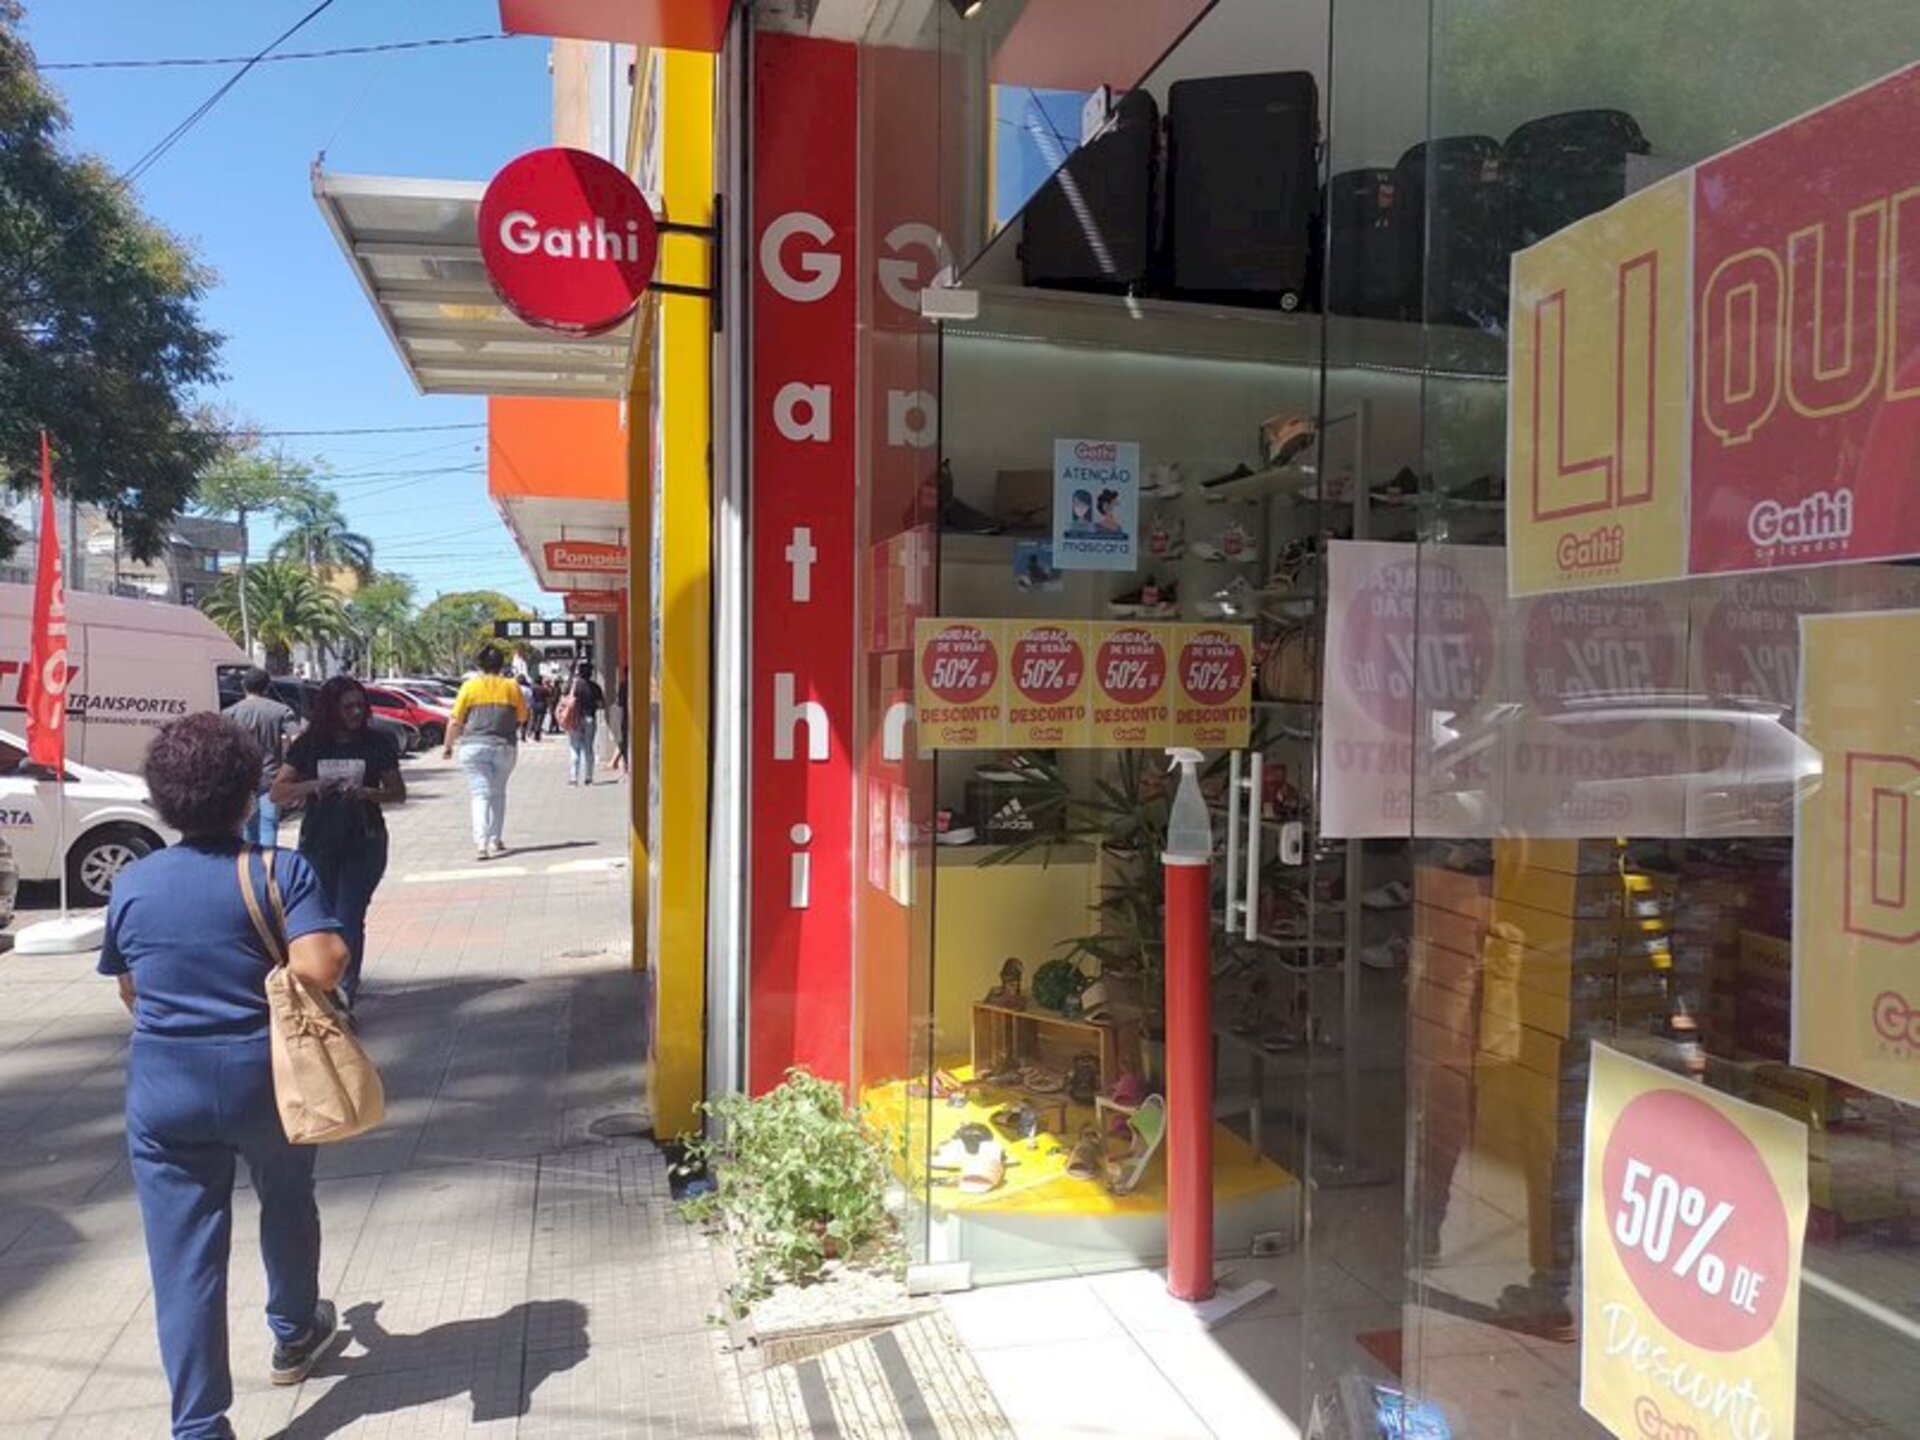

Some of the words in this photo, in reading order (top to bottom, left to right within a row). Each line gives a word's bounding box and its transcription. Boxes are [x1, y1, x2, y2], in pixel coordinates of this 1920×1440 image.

[500, 210, 638, 262] Gathi
[1062, 466, 1130, 484] ATENÇÃO
[1750, 489, 1854, 546] Gathi
[760, 211, 842, 909] Gathi
[1557, 523, 1625, 571] Gathi
[931, 658, 979, 689] 50%
[1019, 659, 1066, 689] 50%
[1105, 661, 1148, 690] 50%
[1186, 662, 1229, 691] 50%
[68, 694, 188, 714] TRANSPORTES
[921, 705, 1000, 723] DESCONTO
[1009, 706, 1085, 723] DESCONTO
[1094, 706, 1168, 723] DESCONTO
[1177, 706, 1247, 724] DESCONTO
[1615, 1156, 1736, 1295] 50%
[1729, 1264, 1766, 1316] DE
